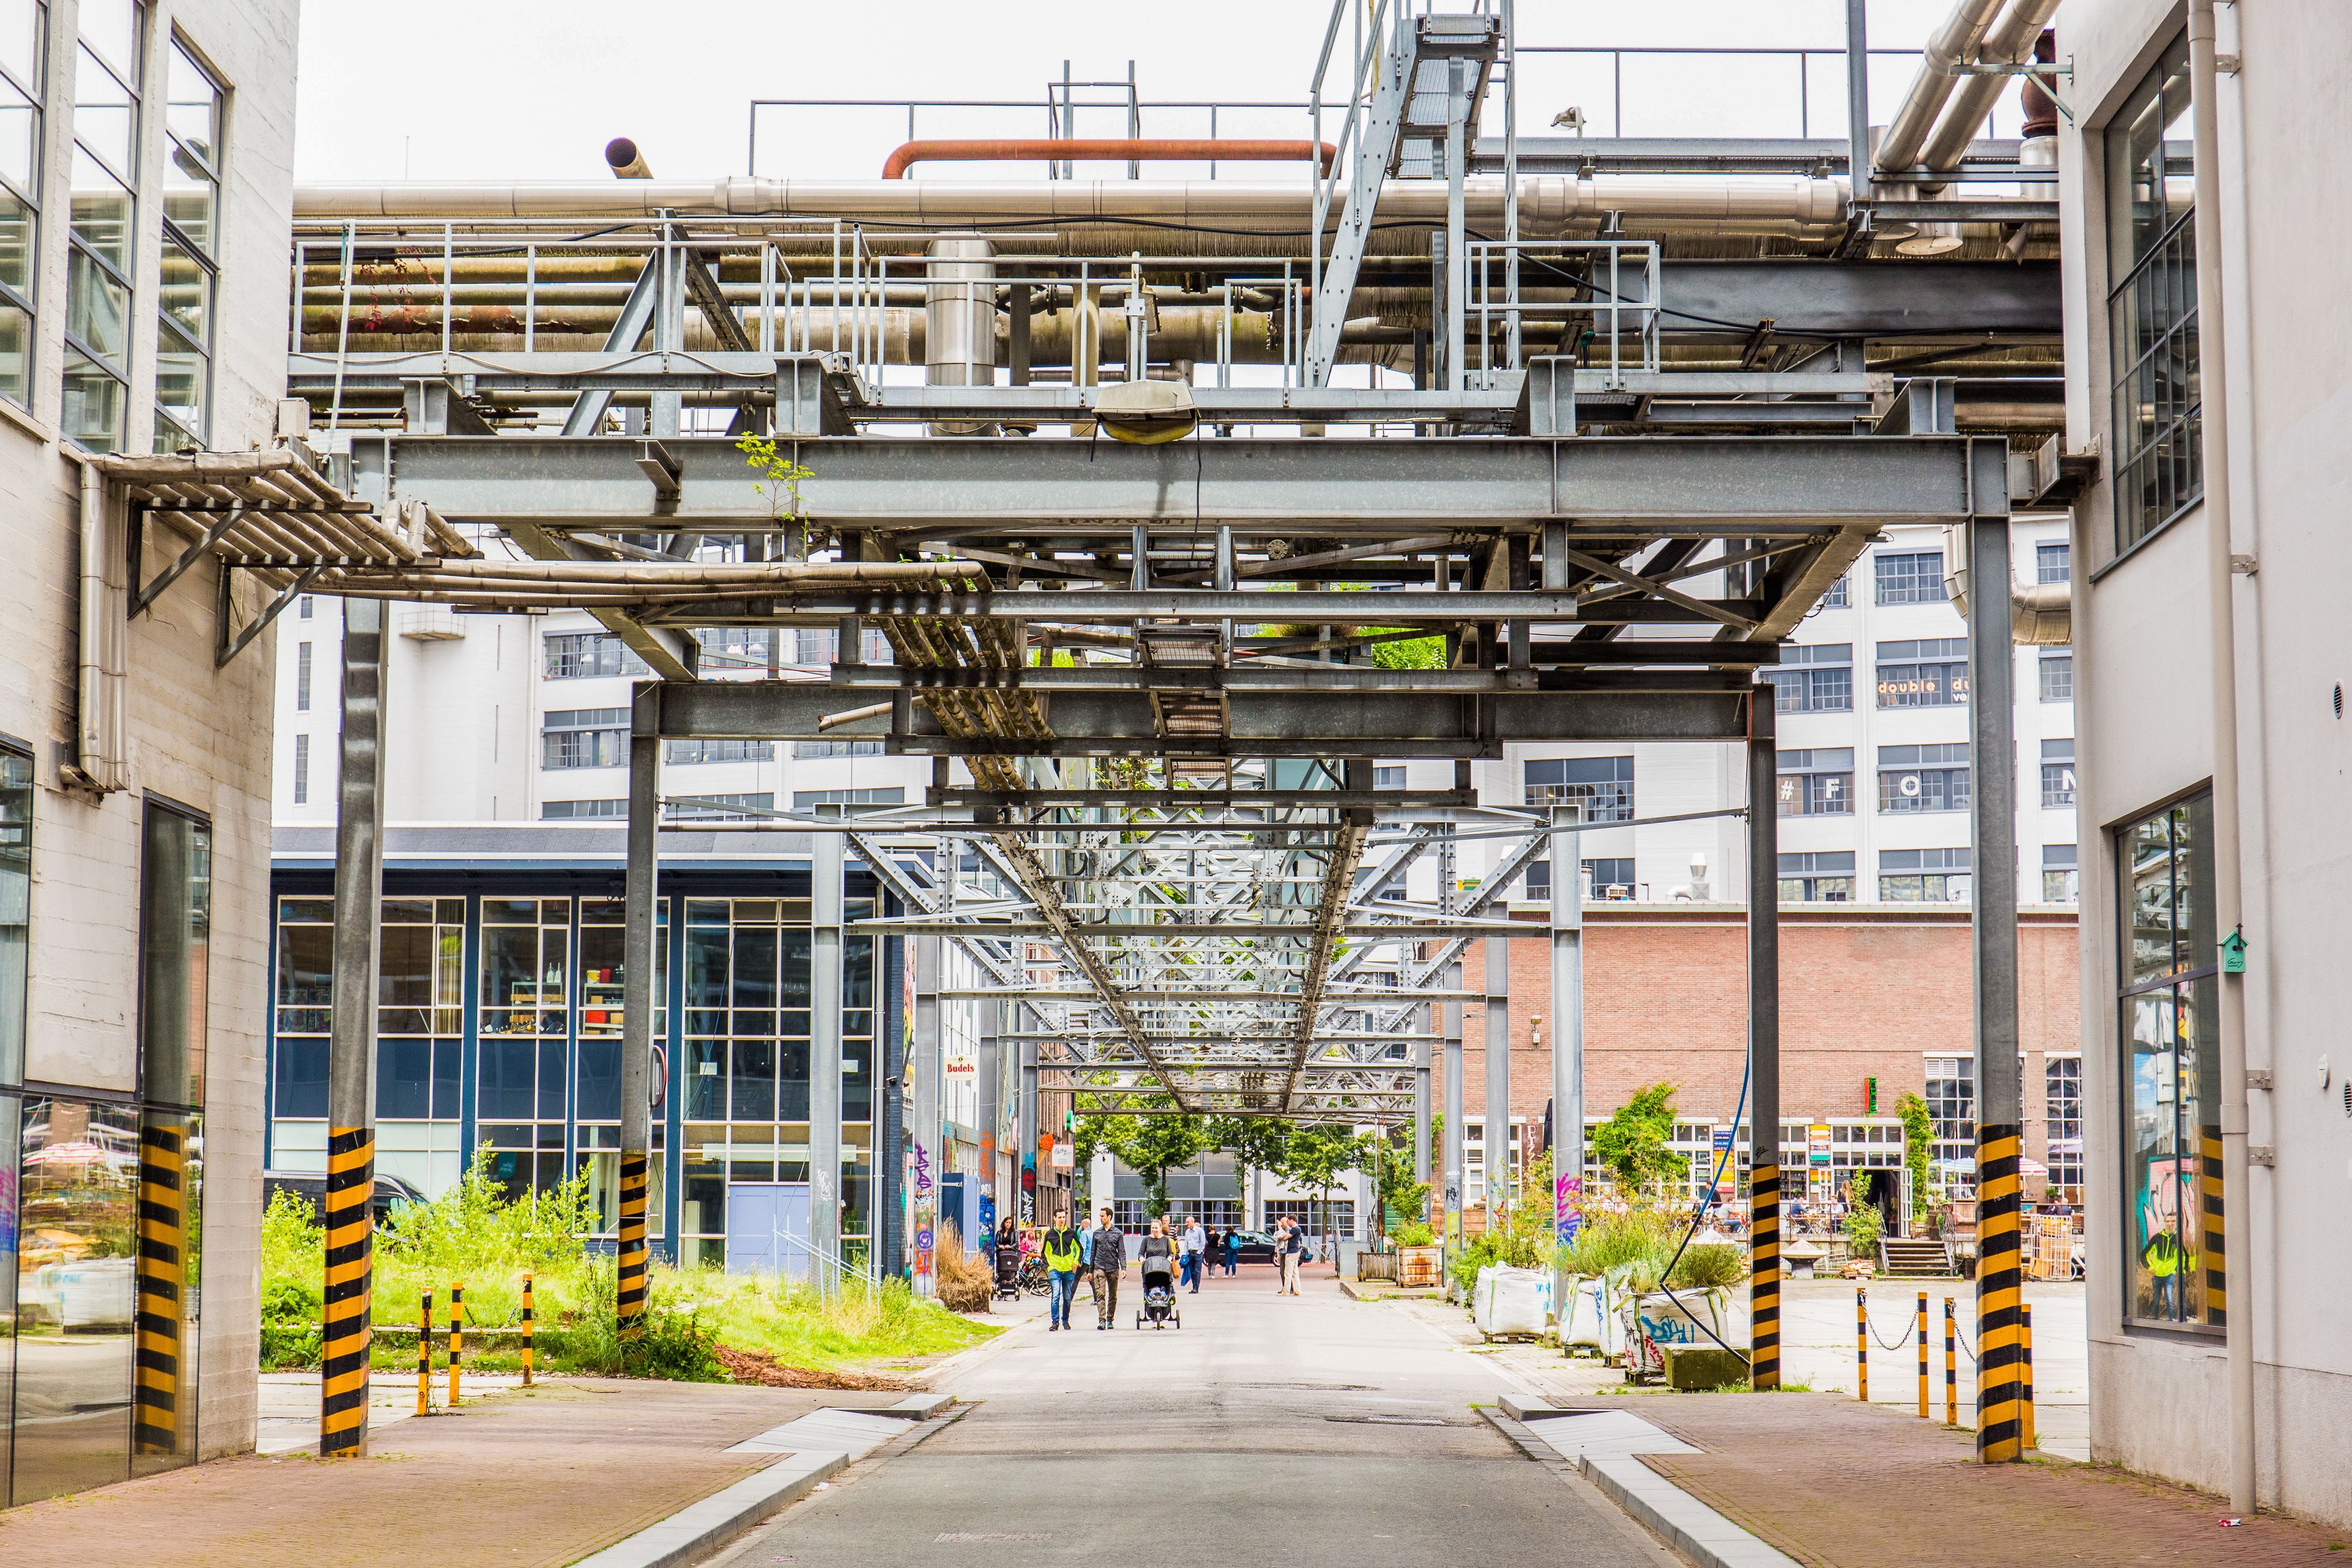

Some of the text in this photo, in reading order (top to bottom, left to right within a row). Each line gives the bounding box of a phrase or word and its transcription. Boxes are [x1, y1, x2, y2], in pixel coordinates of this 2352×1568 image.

[1878, 680, 1936, 694] double
[1953, 693, 1969, 702] ve
[947, 1064, 974, 1072] Budels
